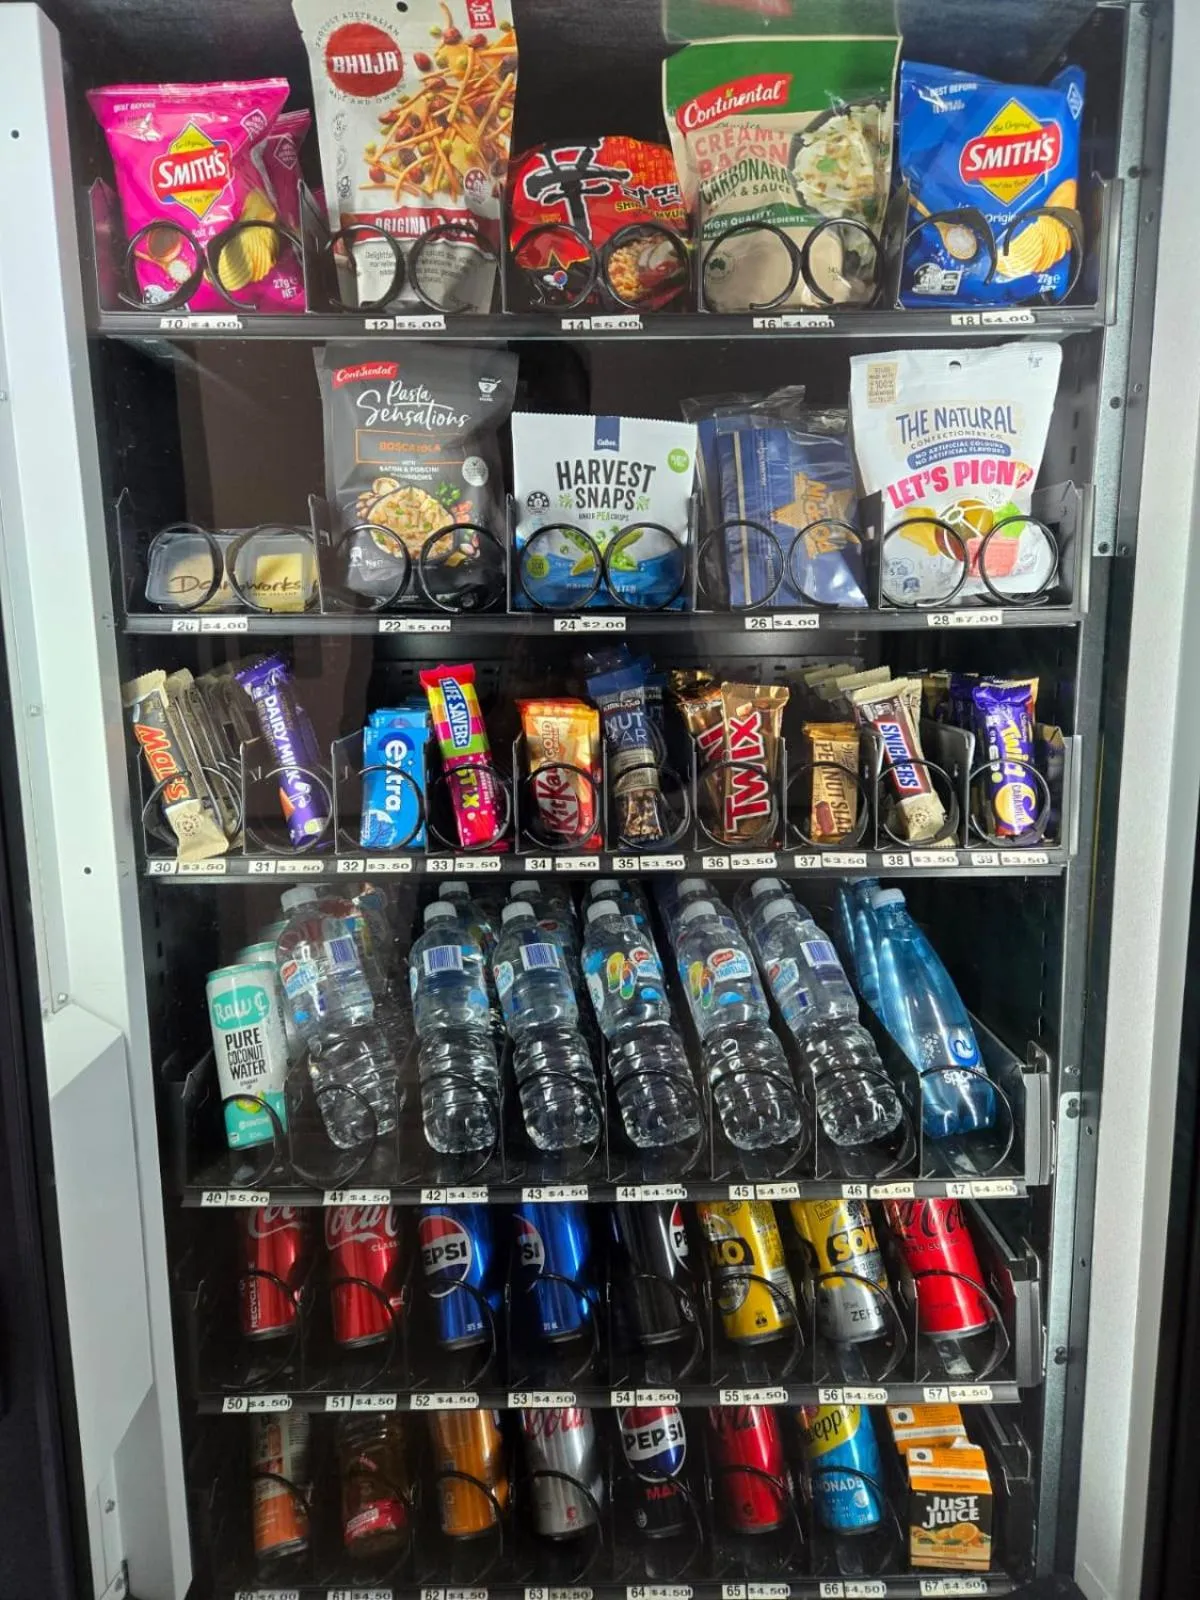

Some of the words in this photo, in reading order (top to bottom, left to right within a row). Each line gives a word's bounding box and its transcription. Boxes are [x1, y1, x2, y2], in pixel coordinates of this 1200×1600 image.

[332, 51, 399, 74] BHUJA
[683, 79, 781, 128] Continental
[966, 133, 1056, 172] SMITH'S
[697, 142, 789, 179] BACON
[158, 150, 226, 189] SMITH'S
[375, 217, 431, 235] ORIGINAL
[167, 320, 183, 330] 10
[372, 321, 389, 330] 12
[568, 321, 585, 330] 14
[760, 319, 776, 329] 16
[958, 316, 975, 326] 18
[983, 314, 1030, 324] $4.00
[387, 380, 431, 406] Pasta
[356, 389, 471, 431] Sensations
[896, 409, 930, 444] THE
[934, 405, 1017, 436] NATURAL
[556, 459, 656, 494] HARVEST
[887, 466, 949, 510] LET'S
[575, 487, 636, 511] SNAPS
[203, 621, 247, 630] $4.00
[560, 619, 576, 631] 24
[582, 621, 625, 629] $2.00
[751, 618, 767, 629] 26
[774, 619, 817, 627] $4.00
[933, 615, 950, 626] 28
[955, 615, 999, 623] $7.00
[385, 621, 401, 632] 22
[441, 680, 461, 702] LIFE
[449, 700, 470, 747] SAVERS
[605, 712, 645, 735] NUT
[264, 696, 289, 744] DAIRY
[278, 744, 300, 785] MILK
[880, 724, 919, 788] SNICKERS
[384, 740, 408, 811] extra
[724, 711, 770, 832] TWIX
[432, 860, 448, 870] 33
[457, 861, 498, 869] $3.50
[531, 860, 546, 869] 34
[555, 861, 597, 869] $3.50
[618, 859, 634, 868] 35
[642, 860, 683, 868] $3.50
[708, 858, 724, 868] 36
[733, 859, 775, 867] $3.50
[800, 857, 816, 866] 37
[824, 857, 866, 866] $3.50
[889, 855, 904, 866] 38
[914, 856, 955, 864] $3.50
[977, 855, 993, 864] 39
[154, 861, 171, 873] 30
[182, 863, 224, 871] $3.50
[255, 861, 270, 871] 31
[343, 861, 359, 871] 32
[369, 862, 410, 870] $3.50
[214, 998, 250, 1025] Raw
[225, 1028, 262, 1050] PURE
[227, 1045, 264, 1066] COCONUT
[230, 1059, 267, 1081] WATER
[527, 1188, 542, 1199] 43
[548, 1189, 587, 1198] $4.50
[621, 1187, 636, 1198] 44
[643, 1188, 683, 1197] $4.50
[734, 1187, 749, 1197] 45
[758, 1187, 796, 1195] $4.50
[848, 1184, 863, 1196] 46
[872, 1186, 910, 1194] $4.50
[951, 1184, 966, 1195] 47
[973, 1184, 1014, 1194] $4.50
[206, 1192, 221, 1203] 40
[229, 1194, 269, 1203] $5.00
[329, 1191, 343, 1202] 41
[351, 1195, 390, 1203] $4.50
[426, 1190, 441, 1201] 42
[449, 1191, 487, 1199] $4.50
[424, 1240, 468, 1267] EPSI
[248, 1278, 259, 1328] RECYCLE
[513, 1394, 528, 1404] 53
[534, 1395, 573, 1404] $4.50
[616, 1392, 630, 1403] 54
[724, 1391, 739, 1401] 55
[743, 1392, 783, 1400] $4.50
[824, 1389, 838, 1400] 56
[845, 1391, 884, 1400] $4.50
[929, 1389, 942, 1399] 57
[227, 1397, 242, 1409] 50
[249, 1398, 290, 1408] $4.50
[332, 1397, 346, 1408] 51
[355, 1397, 394, 1406] $4.50
[415, 1395, 430, 1406] 52
[624, 1421, 684, 1451] PEPSI
[926, 1495, 979, 1512] JUST
[922, 1508, 980, 1529] JUICE
[631, 1587, 645, 1598] 64
[651, 1589, 688, 1597] $4.50
[727, 1586, 741, 1597] 65
[750, 1588, 786, 1596] $4.50
[824, 1583, 839, 1594] 66
[845, 1585, 882, 1594] $4.50
[925, 1582, 939, 1592] 67
[944, 1582, 981, 1590] $4.50
[425, 1590, 440, 1600] 62
[448, 1592, 487, 1600] $4.50
[529, 1590, 544, 1600] 63
